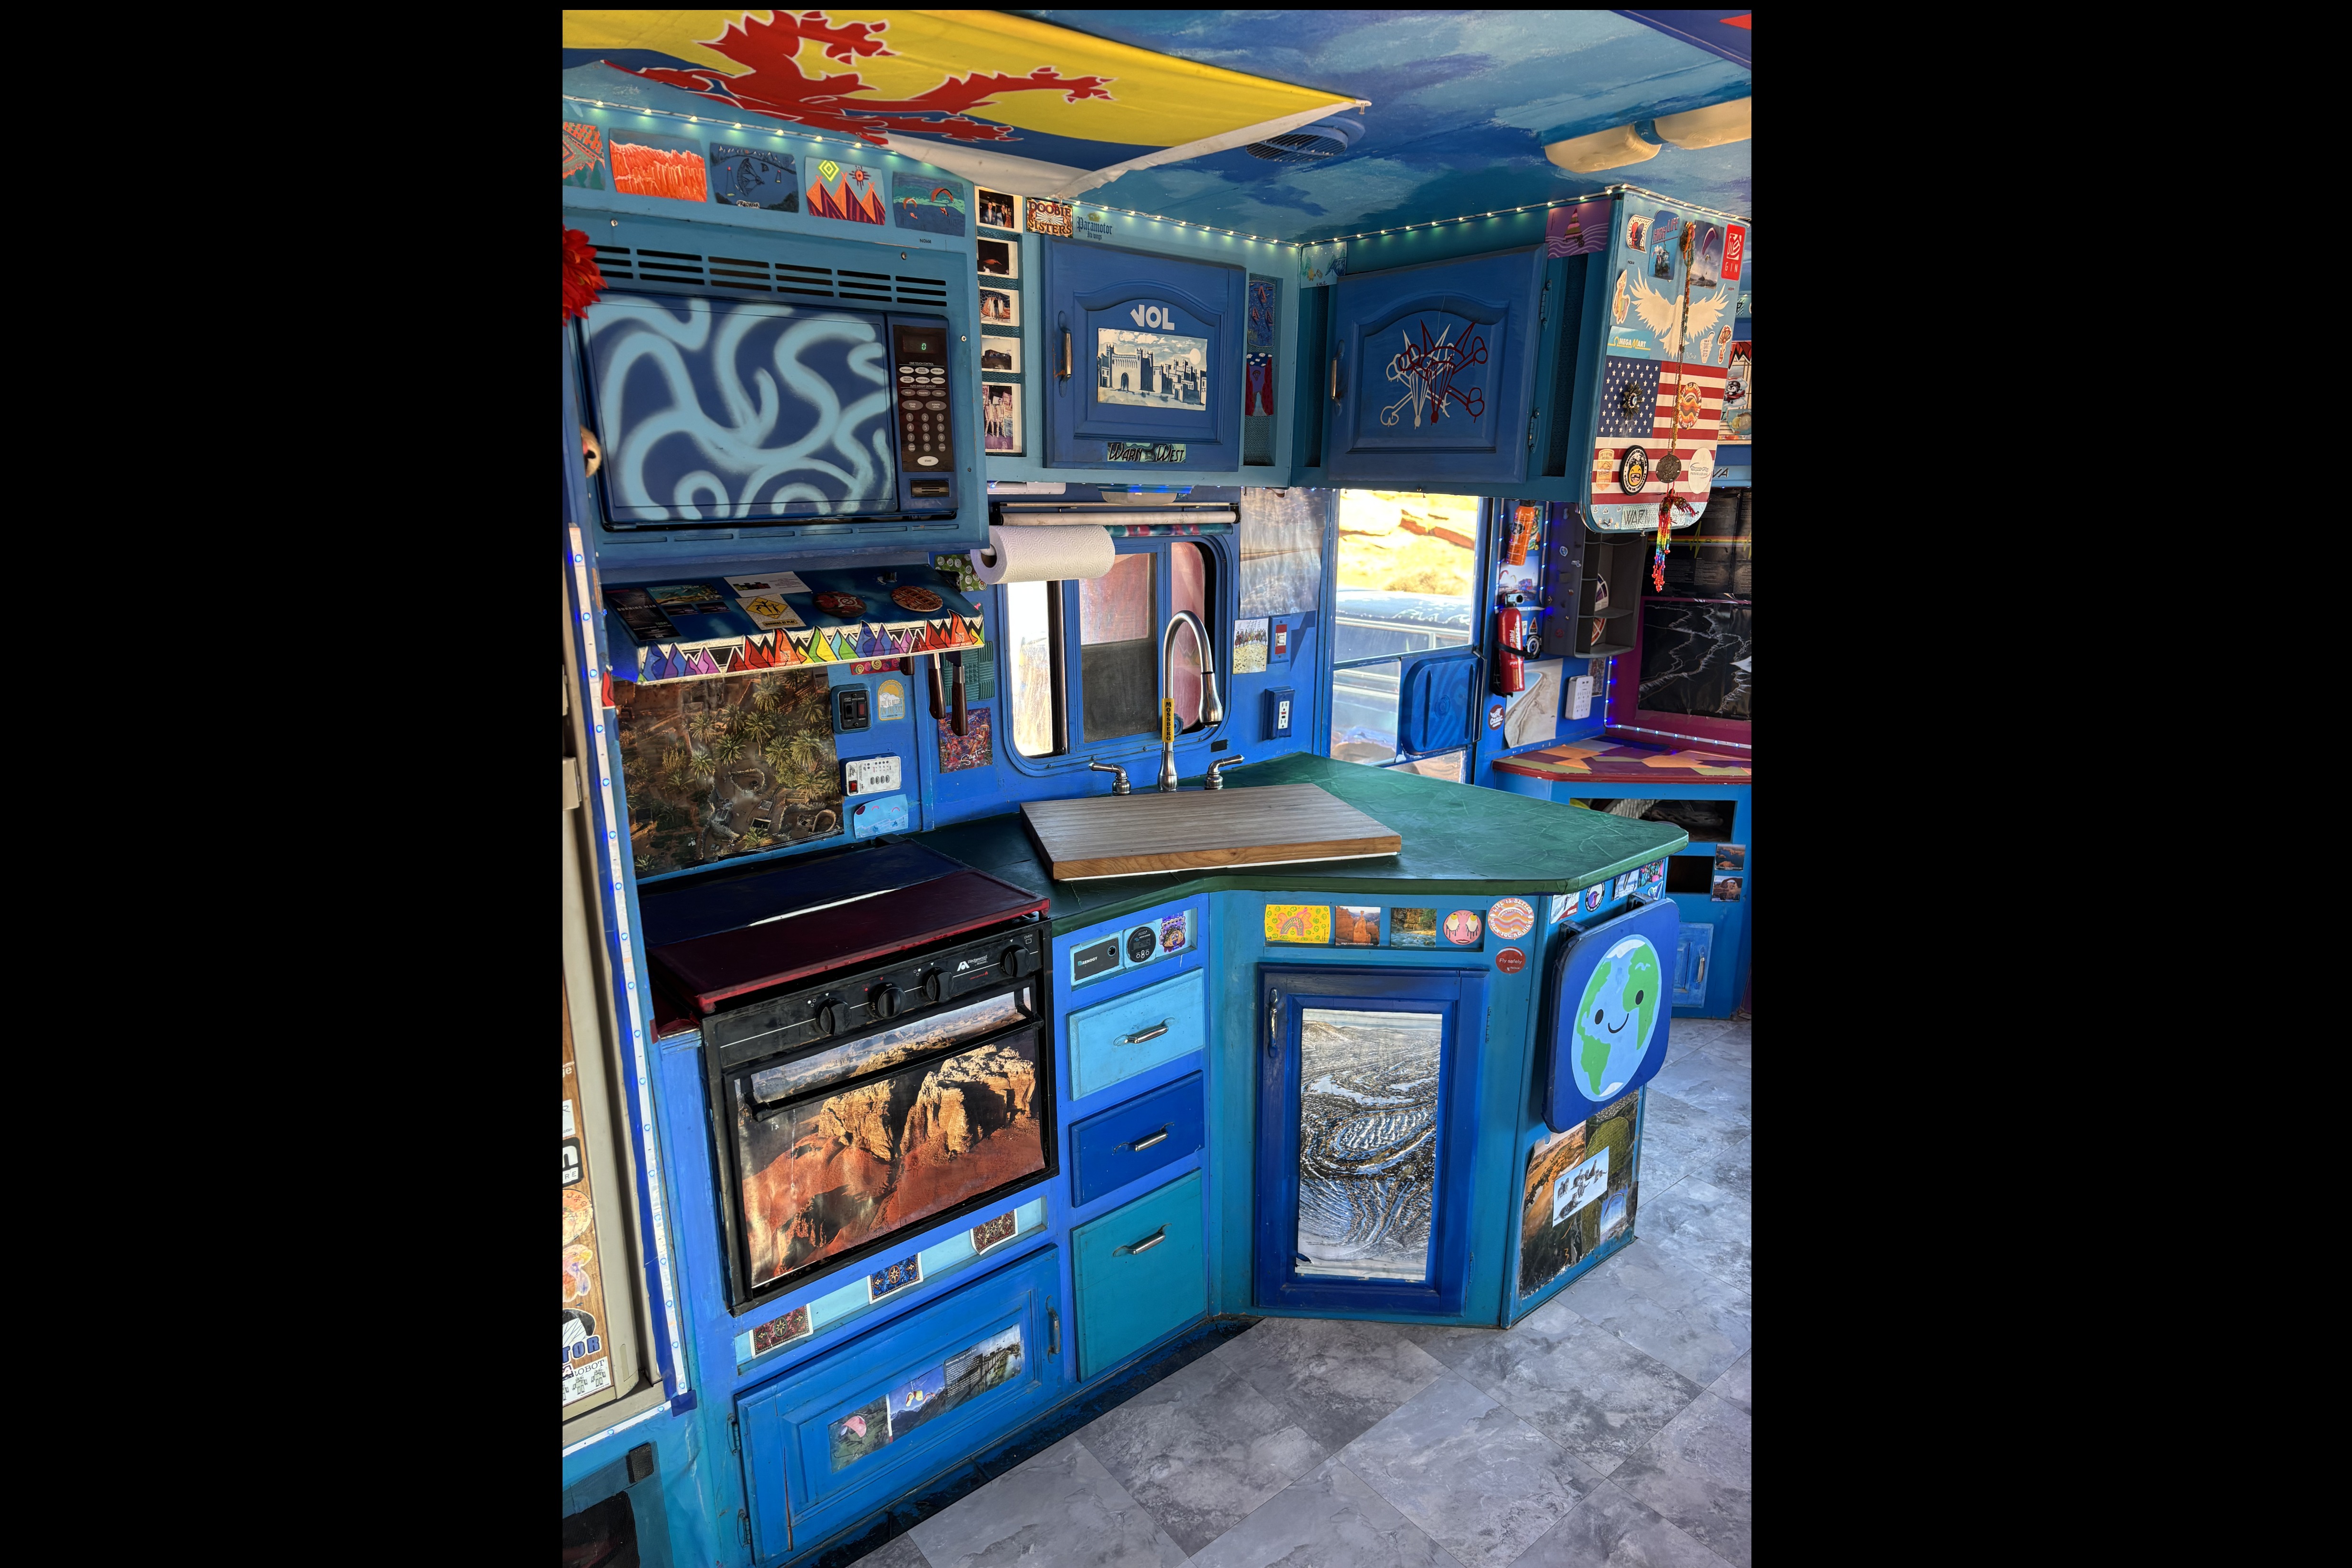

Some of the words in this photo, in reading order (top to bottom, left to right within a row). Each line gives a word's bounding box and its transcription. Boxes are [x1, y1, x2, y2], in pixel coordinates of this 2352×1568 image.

[1028, 218, 1072, 234] SISTERS
[1077, 216, 1113, 235] Paramotor
[1725, 262, 1739, 273] GIN
[1130, 304, 1175, 331] VOL
[1631, 339, 1646, 348] MART
[1108, 443, 1142, 462] WARN
[1156, 444, 1185, 462] WEST
[1490, 714, 1503, 725] Craic
[961, 747, 991, 766] Santana
[1492, 901, 1504, 913] LIFE
[1514, 898, 1532, 914] BETTER
[1490, 918, 1500, 934] WHEN
[1522, 920, 1532, 933] HIGH
[967, 954, 988, 964] Wedgewood
[1081, 956, 1098, 965] RENOGY
[946, 1358, 959, 1366] Naturally
